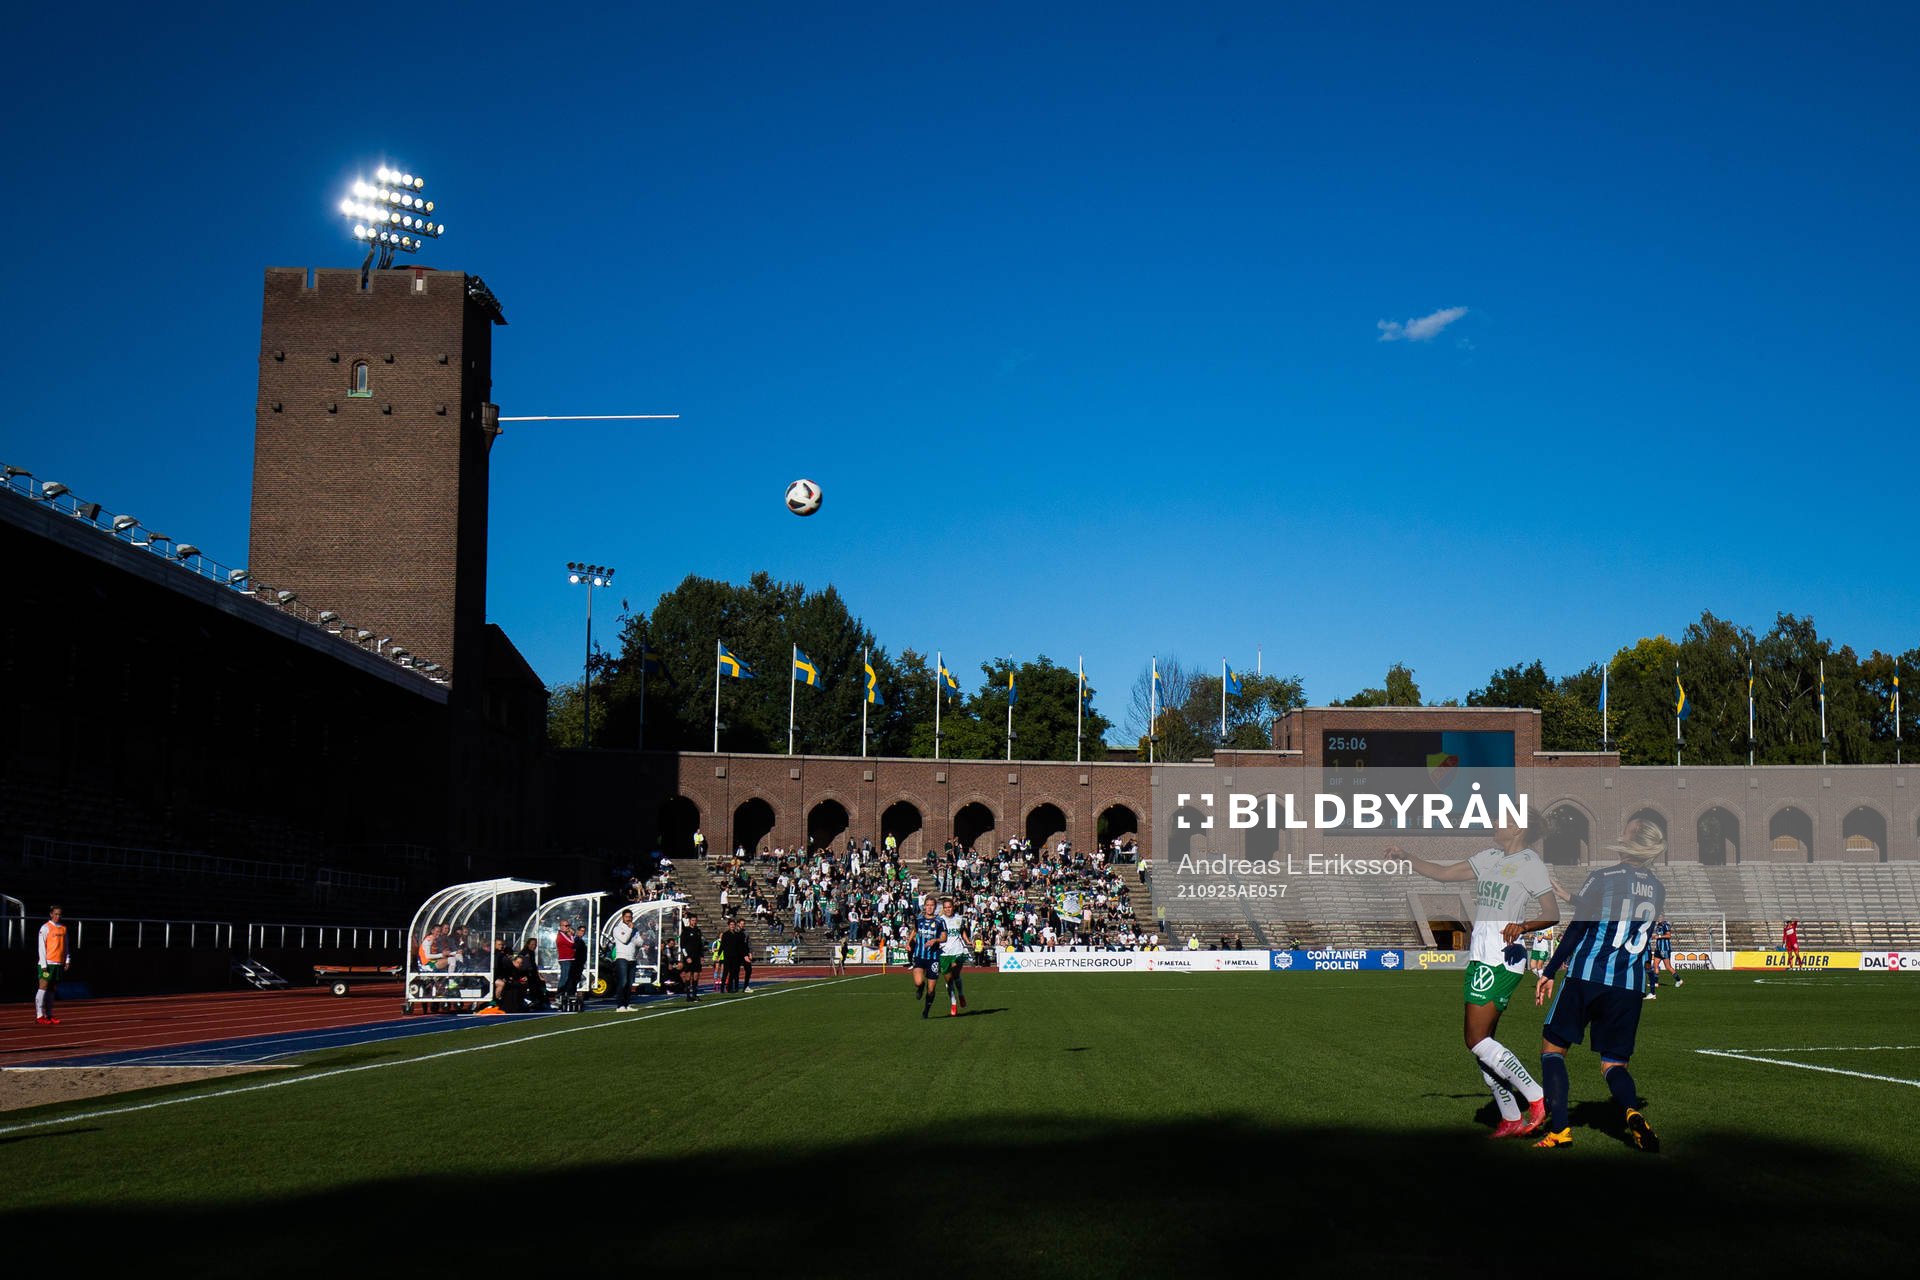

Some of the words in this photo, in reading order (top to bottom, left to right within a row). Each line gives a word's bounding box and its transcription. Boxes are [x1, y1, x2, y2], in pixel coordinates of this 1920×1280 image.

[1328, 737, 1367, 750] 25:06
[1477, 880, 1510, 901] USKI
[1631, 881, 1653, 898] LÅNG
[1612, 898, 1656, 954] 13
[1021, 958, 1132, 967] ONEPARTNERGROUP
[1307, 951, 1367, 960] CONTAINER
[1418, 953, 1456, 970] gibon
[1864, 956, 1907, 968] DALOC
[1315, 961, 1359, 970] POOLEN
[1499, 1050, 1533, 1085] Clinton
